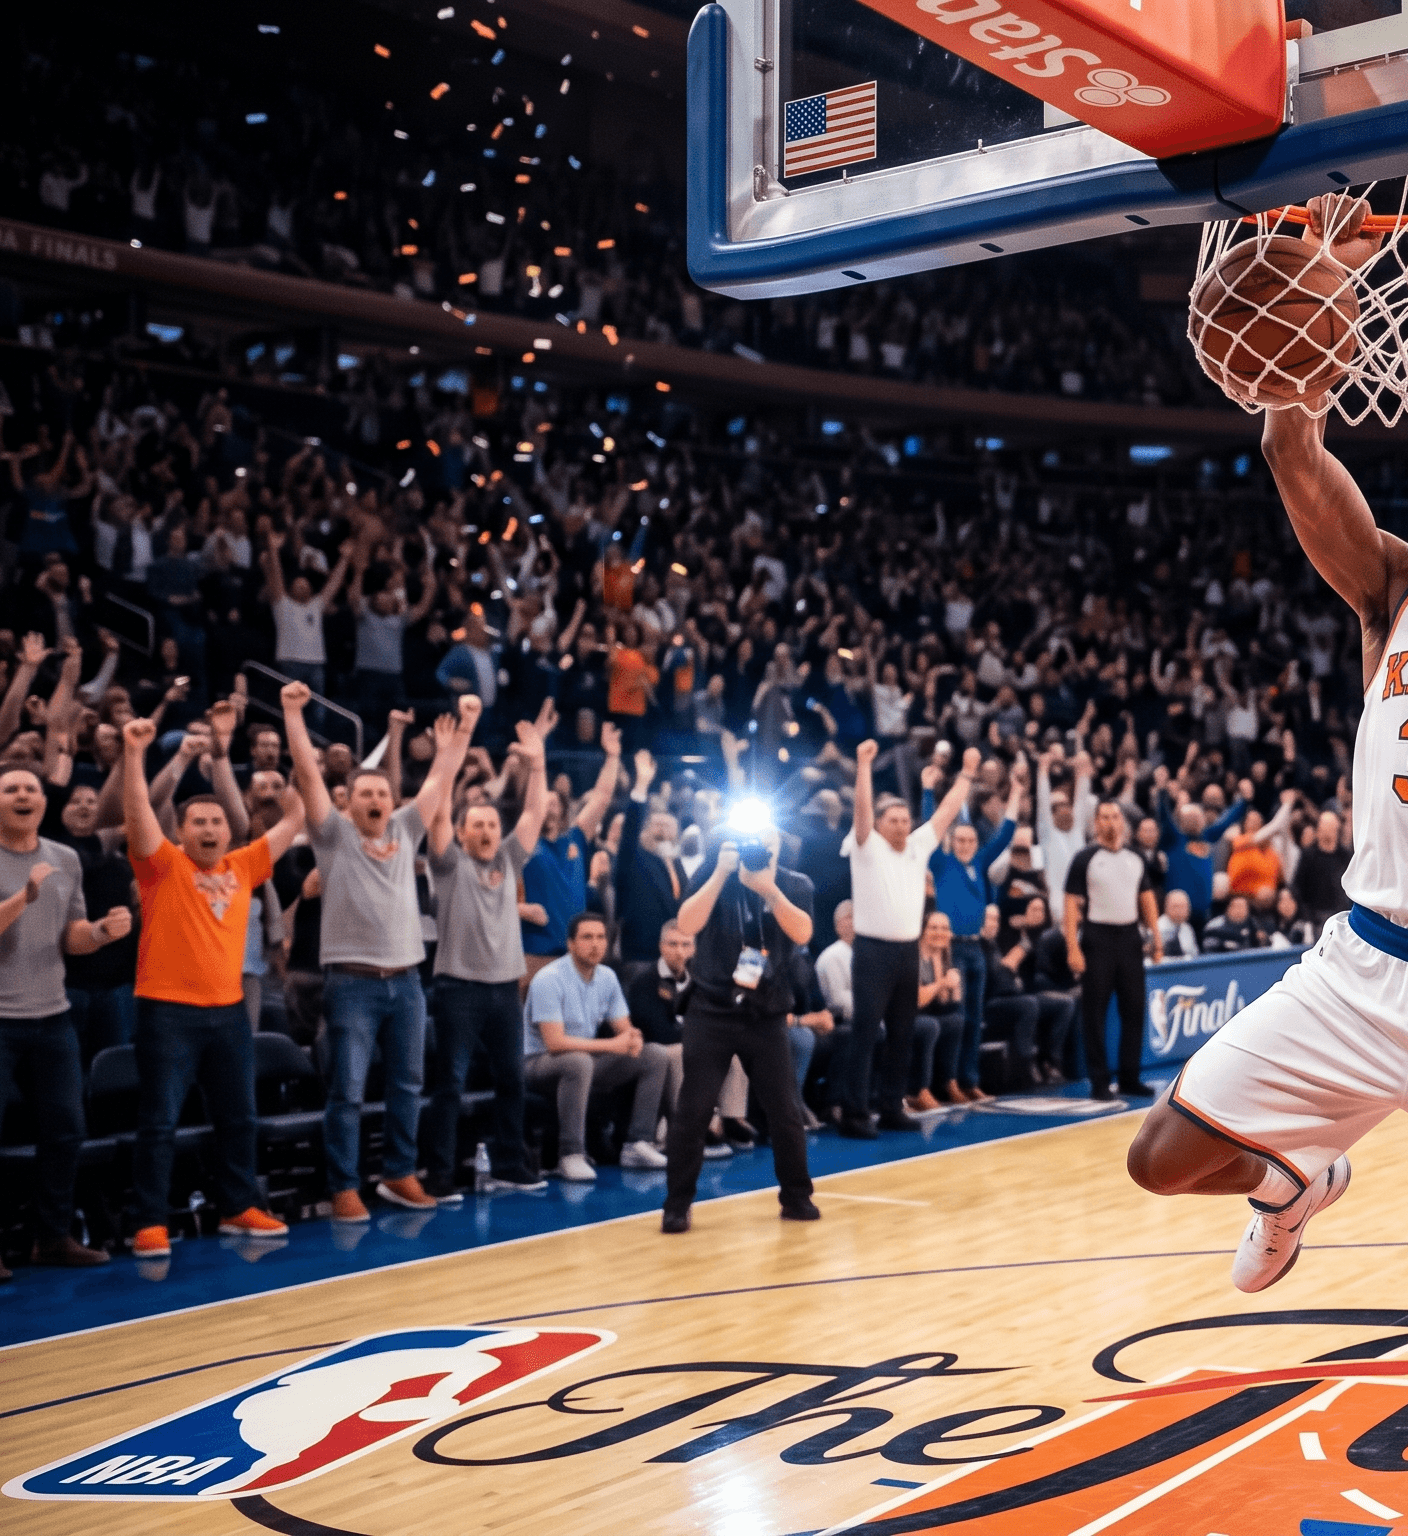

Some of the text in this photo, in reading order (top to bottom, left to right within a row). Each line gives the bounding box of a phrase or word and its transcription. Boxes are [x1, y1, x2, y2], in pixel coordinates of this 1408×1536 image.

[30, 233, 118, 271] FINALS
[412, 1351, 1066, 1466] The
[58, 1455, 234, 1486] NBA
